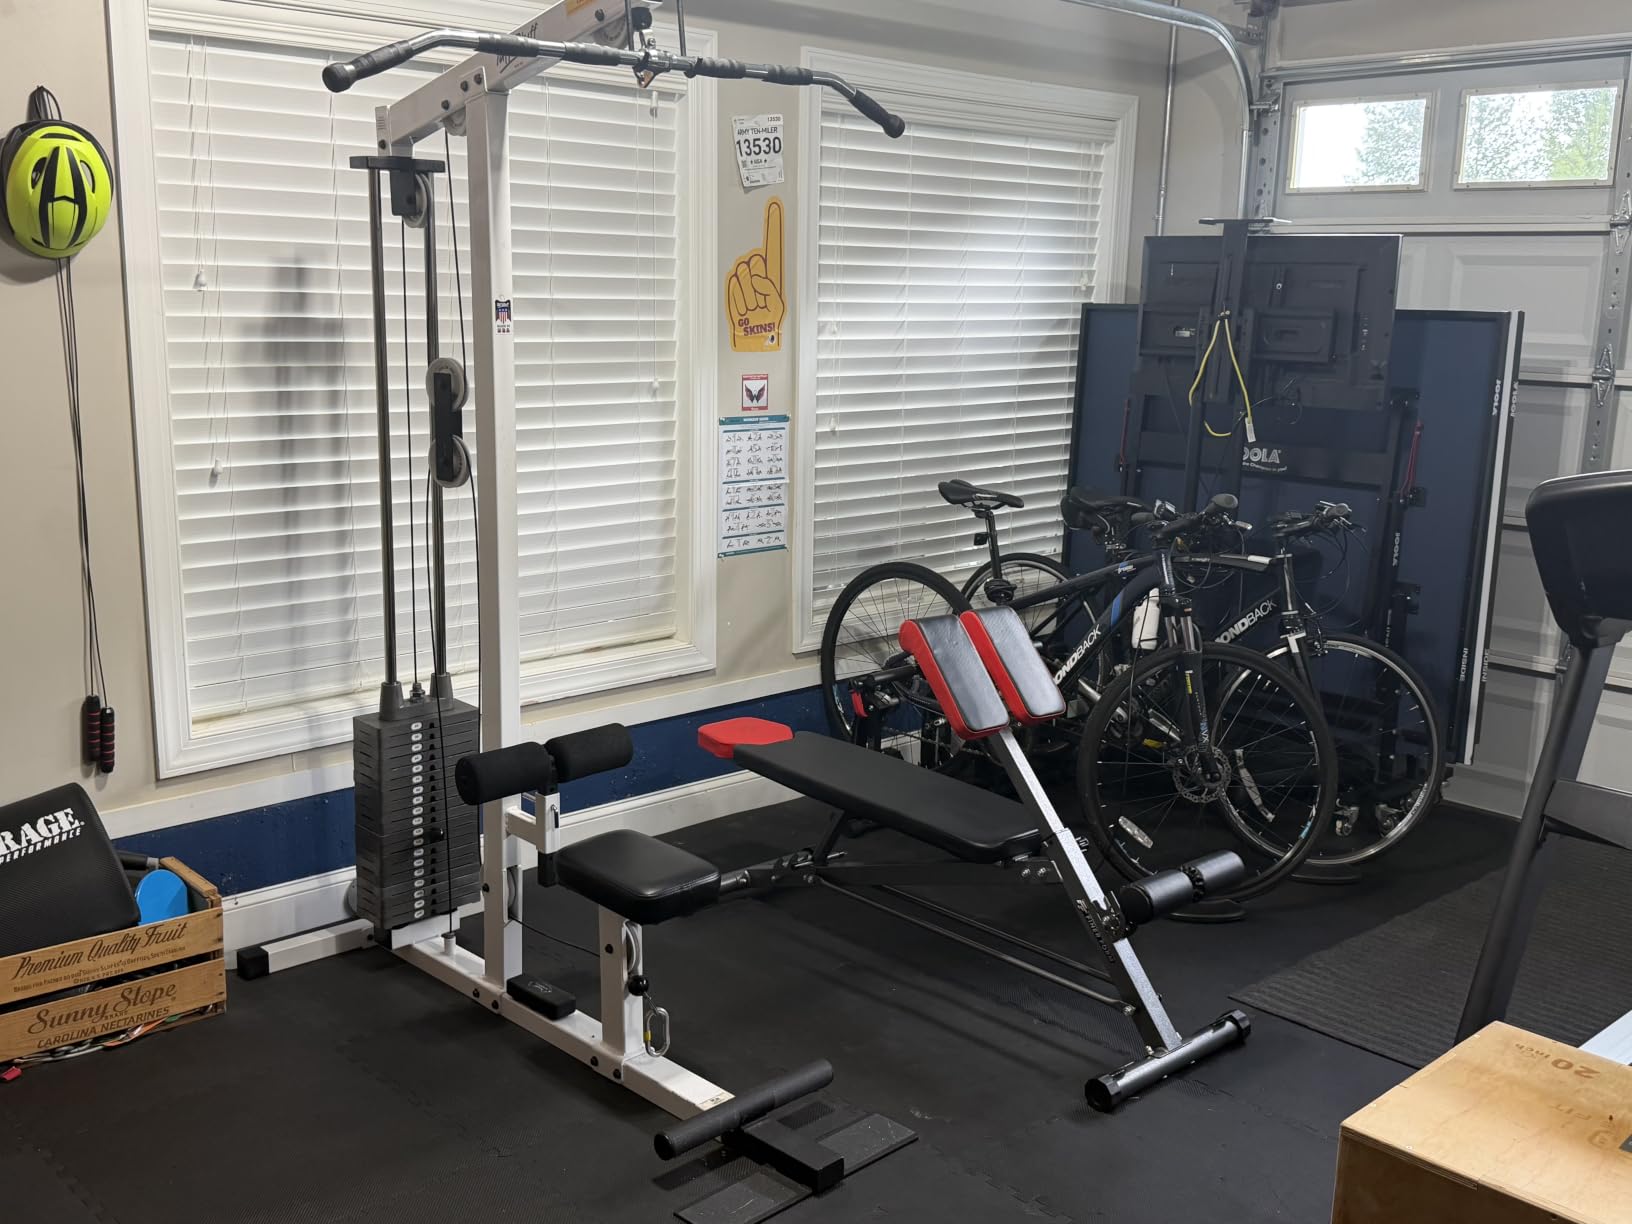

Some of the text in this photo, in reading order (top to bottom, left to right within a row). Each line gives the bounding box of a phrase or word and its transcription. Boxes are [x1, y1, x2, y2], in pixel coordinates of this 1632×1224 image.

[737, 126, 778, 136] ARMY TEN-MILER
[736, 136, 782, 157] 13530
[738, 317, 750, 327] GO
[743, 322, 776, 336] SKINS!
[1242, 446, 1280, 464] OOLA
[1215, 599, 1278, 644] ONDBACK
[1053, 623, 1102, 685] ONDBACK
[0, 827, 81, 865] PERFORMANCE
[11, 951, 84, 980] Premium
[87, 932, 142, 962] Quality
[141, 922, 188, 948] Fruit
[28, 983, 177, 1034] Sunny Slope
[37, 1006, 170, 1049] CAROLINA NECTARINES
[1551, 1058, 1601, 1079] 20
